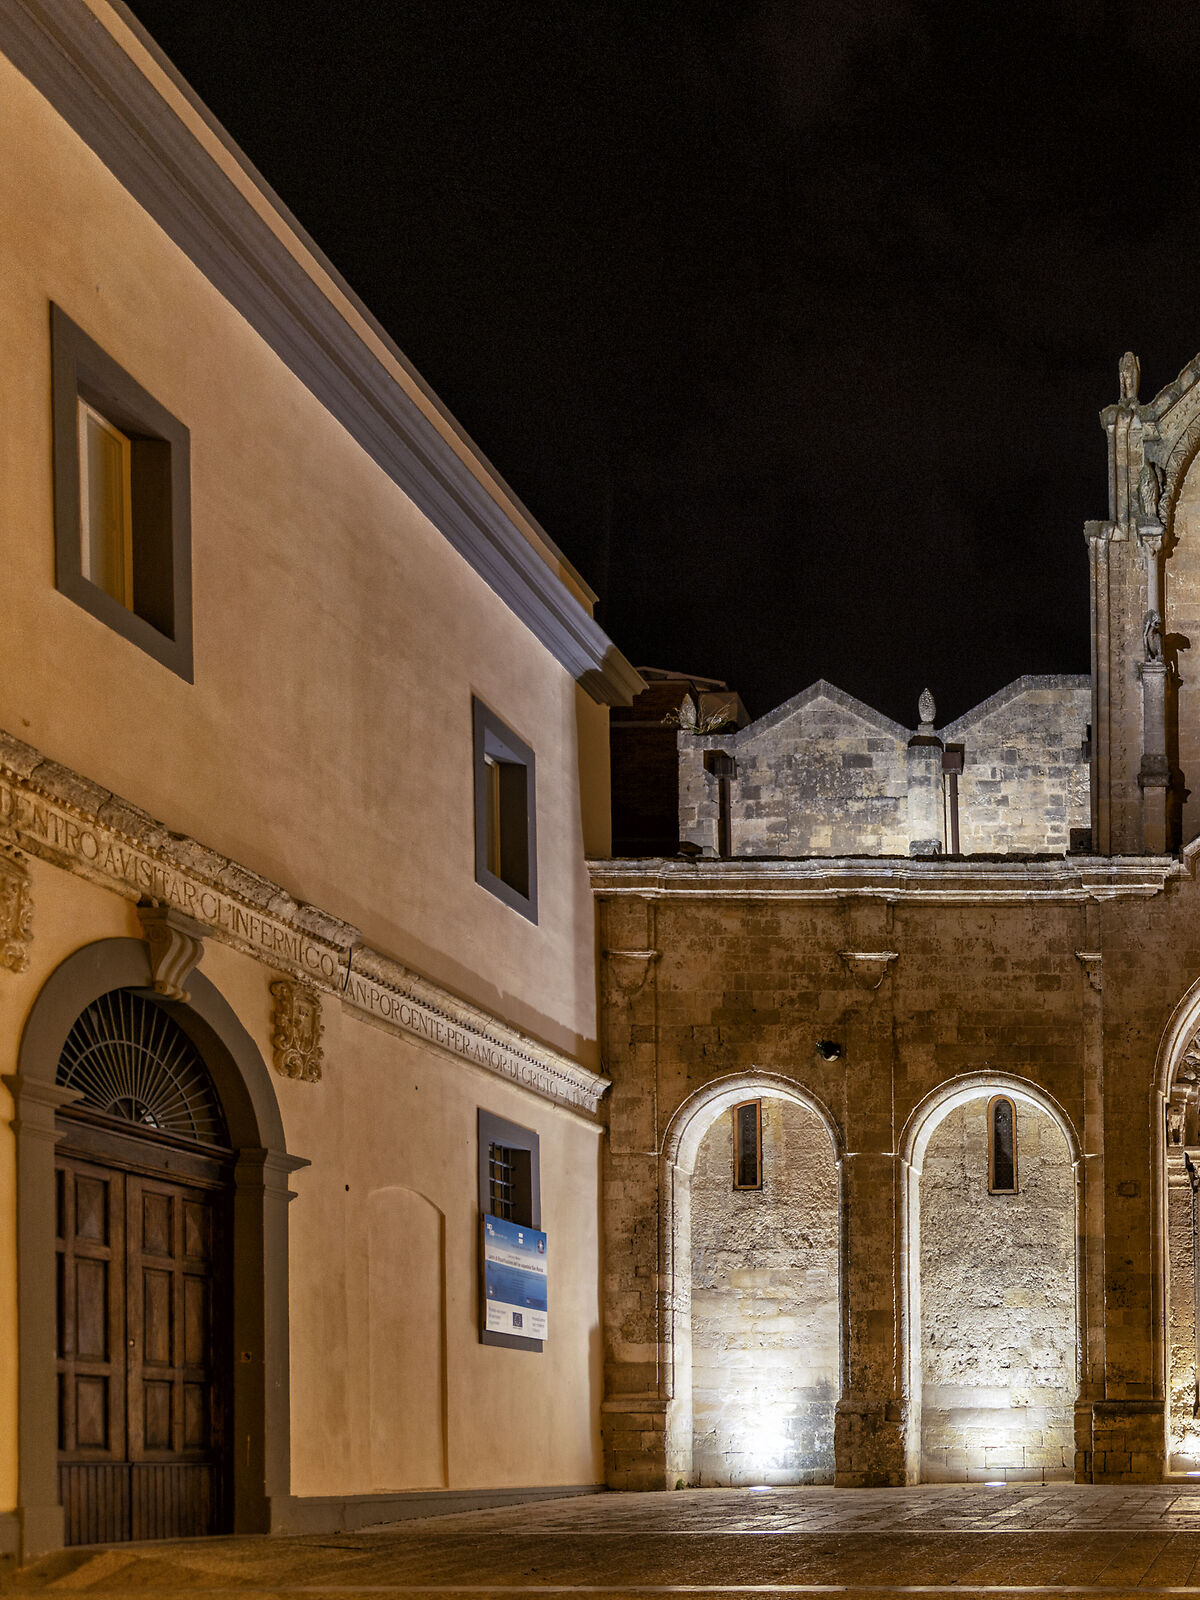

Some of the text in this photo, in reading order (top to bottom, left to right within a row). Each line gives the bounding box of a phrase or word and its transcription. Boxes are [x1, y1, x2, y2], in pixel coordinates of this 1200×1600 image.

[119, 848, 196, 918] VISITAR
[446, 1027, 470, 1056] PER
[474, 1044, 510, 1072] AMOR
[521, 1066, 558, 1098] CRISTO
